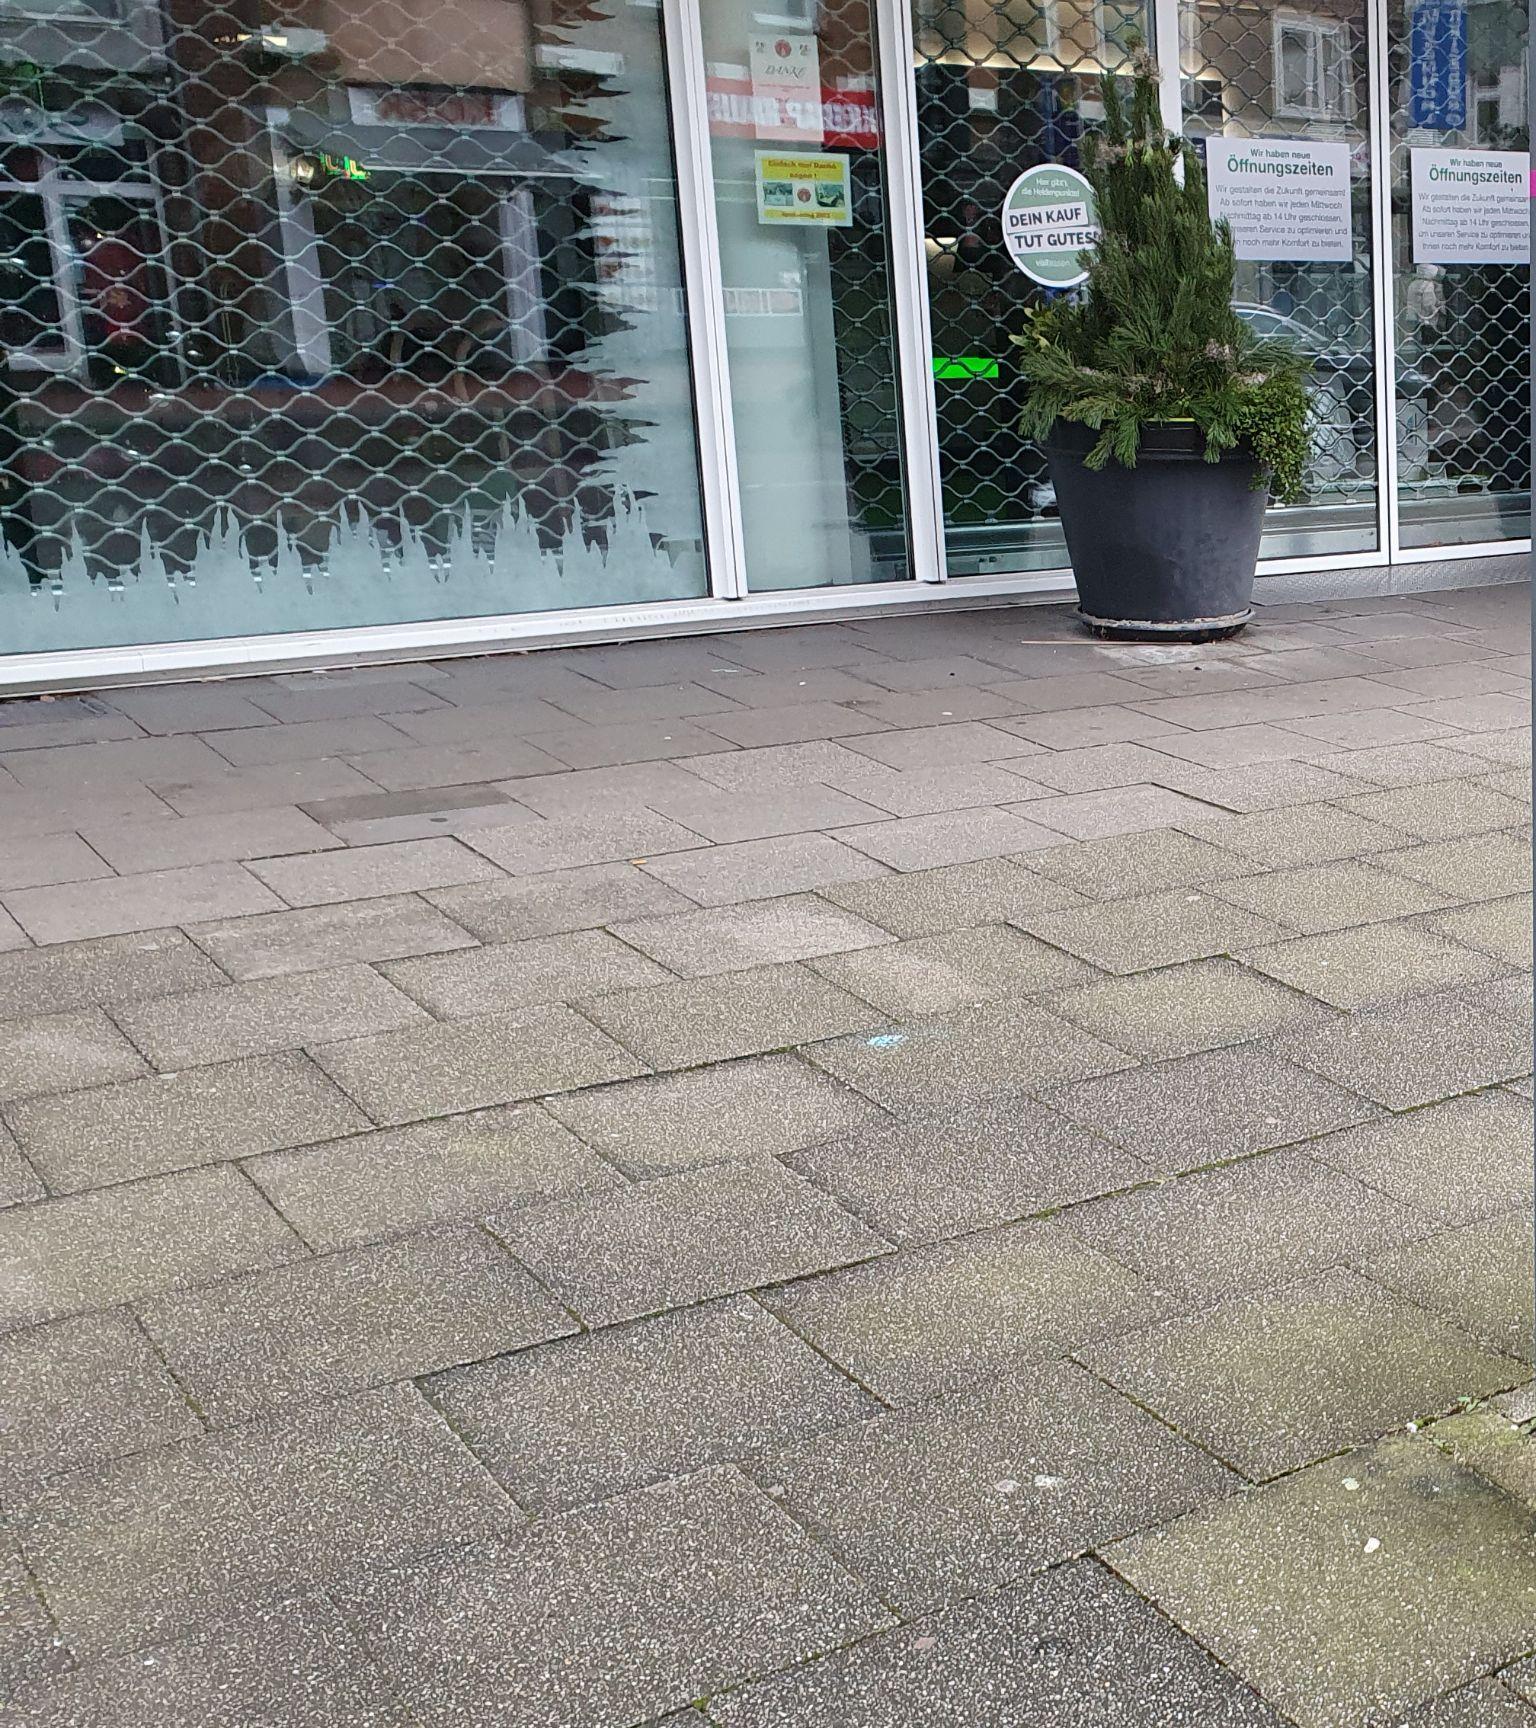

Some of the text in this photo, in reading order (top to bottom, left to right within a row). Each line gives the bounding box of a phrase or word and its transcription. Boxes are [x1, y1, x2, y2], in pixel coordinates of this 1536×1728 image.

[1250, 148, 1311, 160] Wir haben neue
[1449, 158, 1461, 167] Wir
[1463, 158, 1484, 168] haben
[1227, 154, 1334, 178] Öffnungszeiten
[1429, 164, 1522, 185] Öffnungszeiten
[1009, 207, 1082, 228] DEIN KAUF
[1014, 233, 1044, 249] TUT
